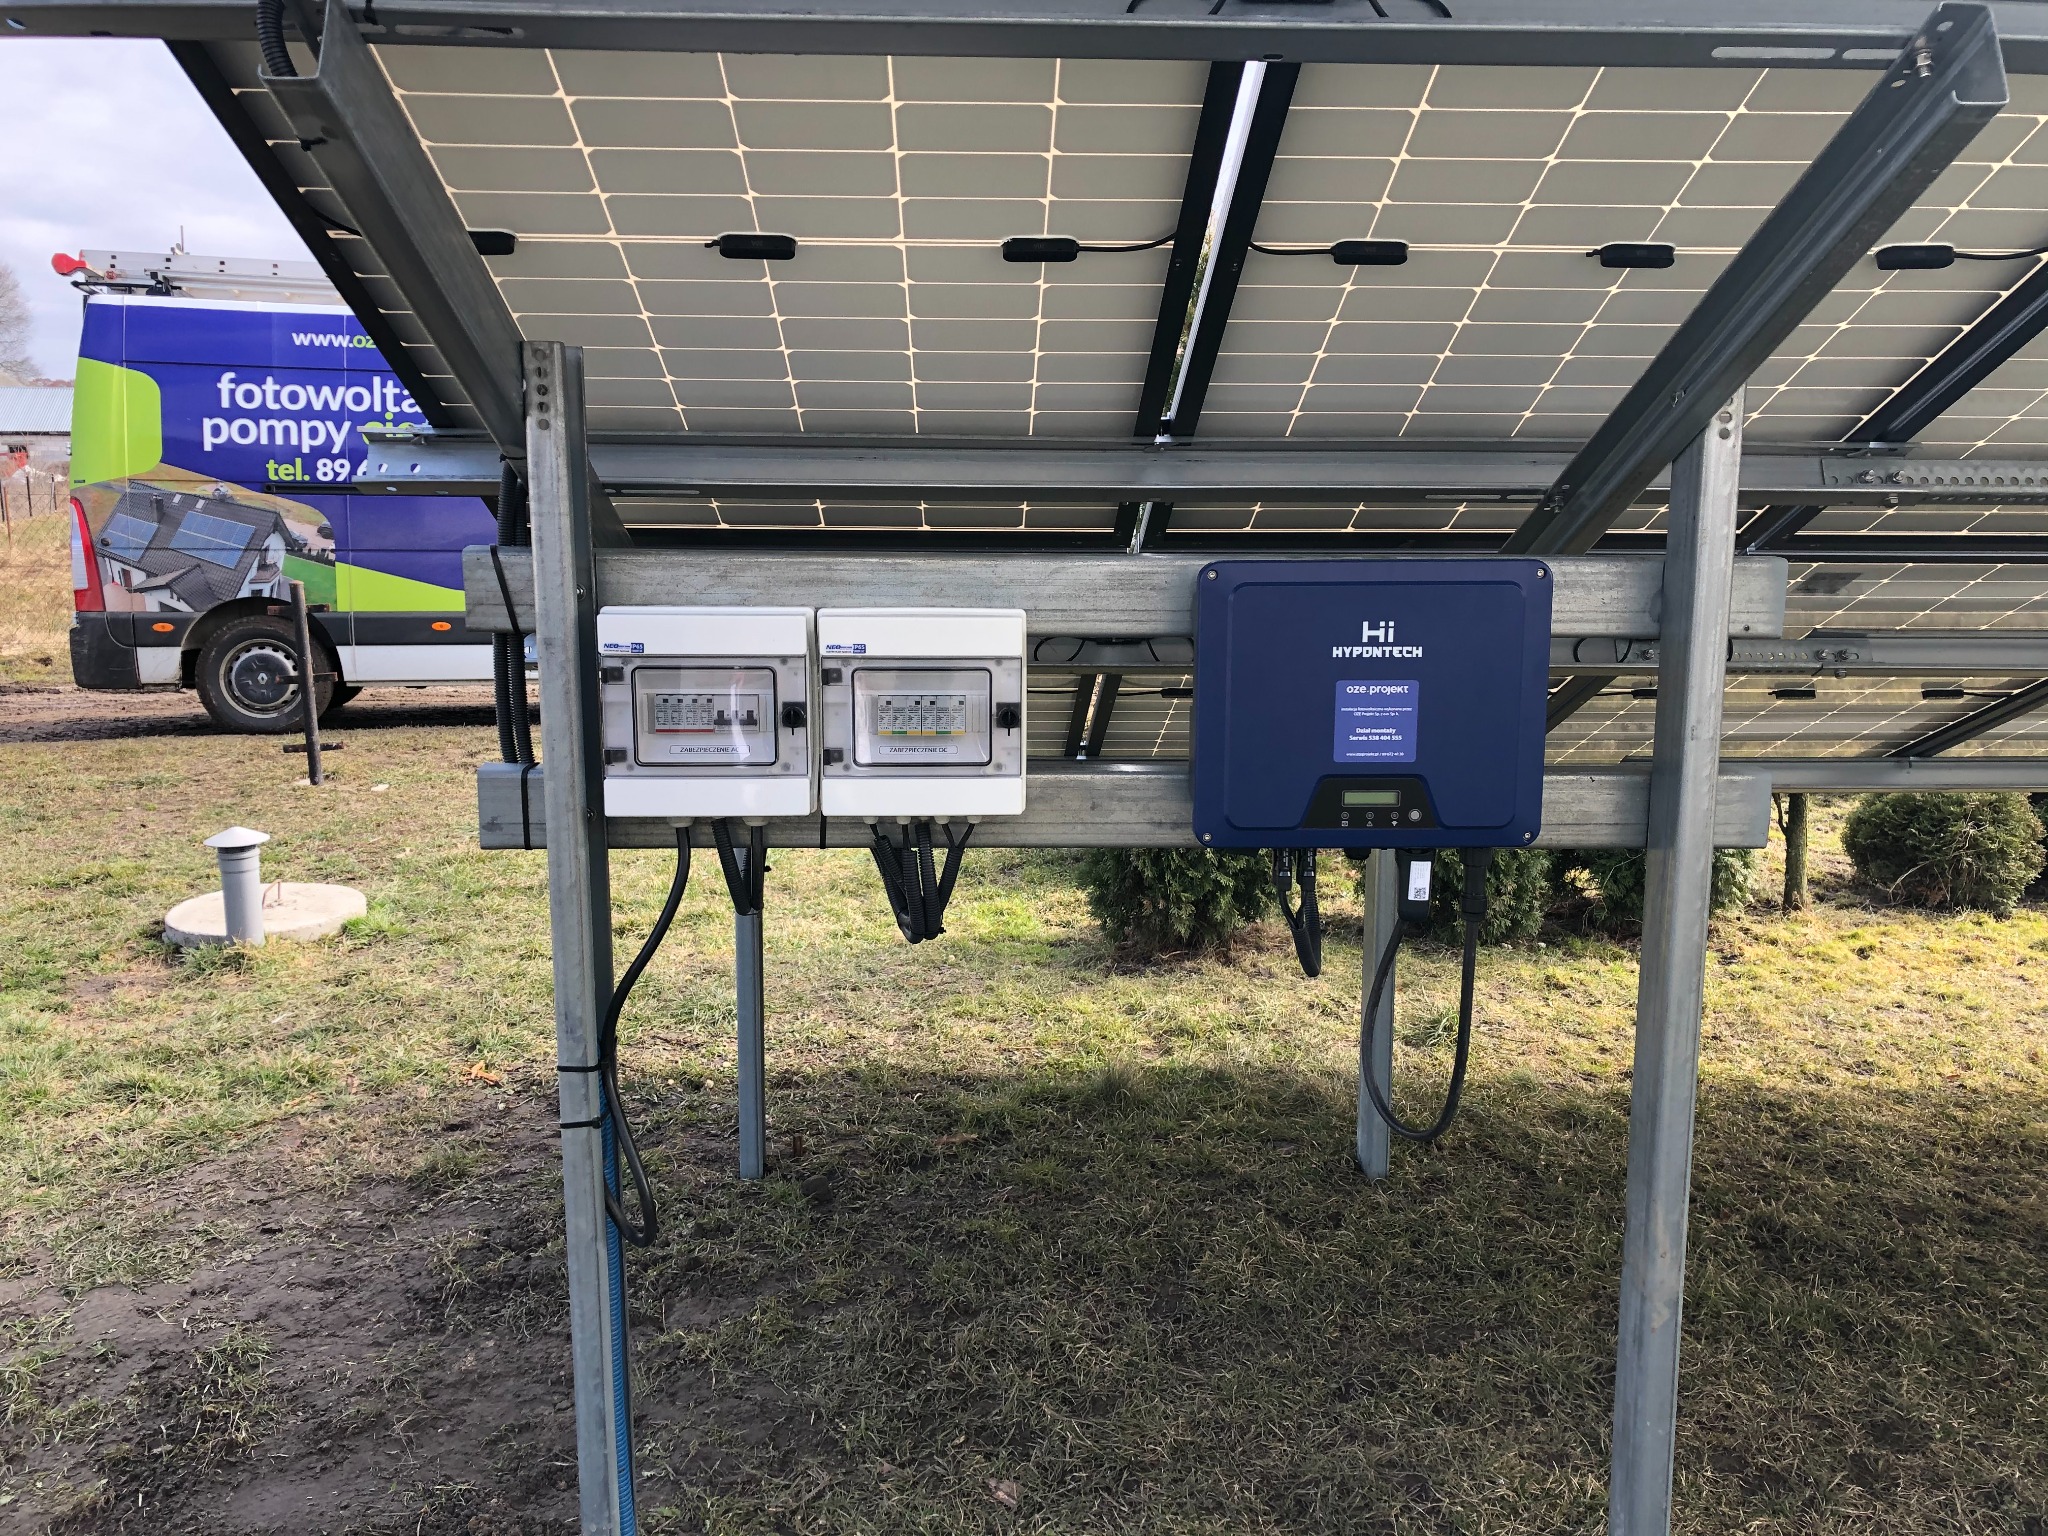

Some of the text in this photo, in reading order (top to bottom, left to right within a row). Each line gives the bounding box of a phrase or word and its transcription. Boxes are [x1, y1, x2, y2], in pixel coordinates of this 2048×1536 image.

[203, 415, 352, 454] pompy
[266, 458, 310, 481] tel.
[316, 458, 350, 482] 89
[1362, 621, 1395, 643] Hi
[1332, 646, 1423, 658] HYPONTECH
[1346, 685, 1409, 695] oze.projekt
